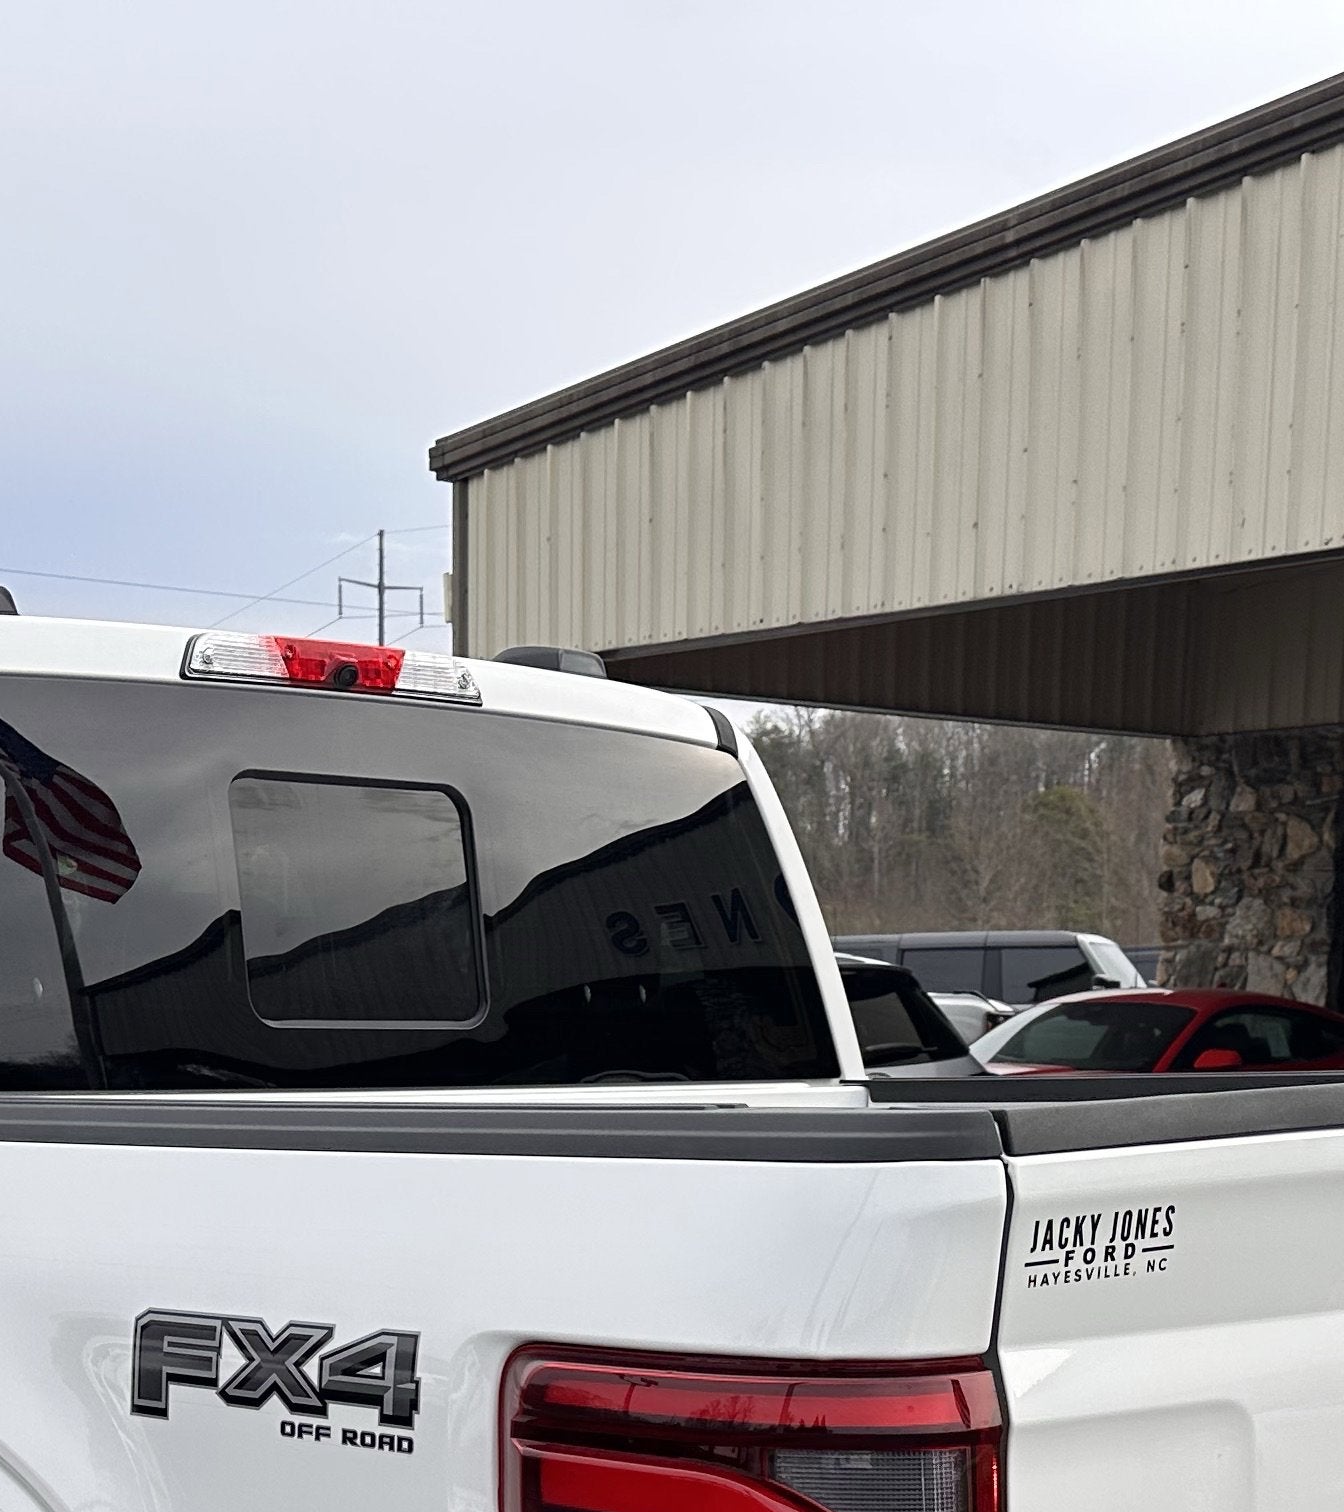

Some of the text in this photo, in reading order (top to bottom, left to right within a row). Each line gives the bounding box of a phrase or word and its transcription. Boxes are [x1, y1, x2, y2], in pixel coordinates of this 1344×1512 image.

[1030, 1205, 1176, 1253] JACKY JONES
[1063, 1242, 1136, 1267] FORD
[1027, 1257, 1168, 1289] HAYESVILLE, NC
[130, 1307, 421, 1430] FX4
[280, 1420, 414, 1454] OFF ROAD
